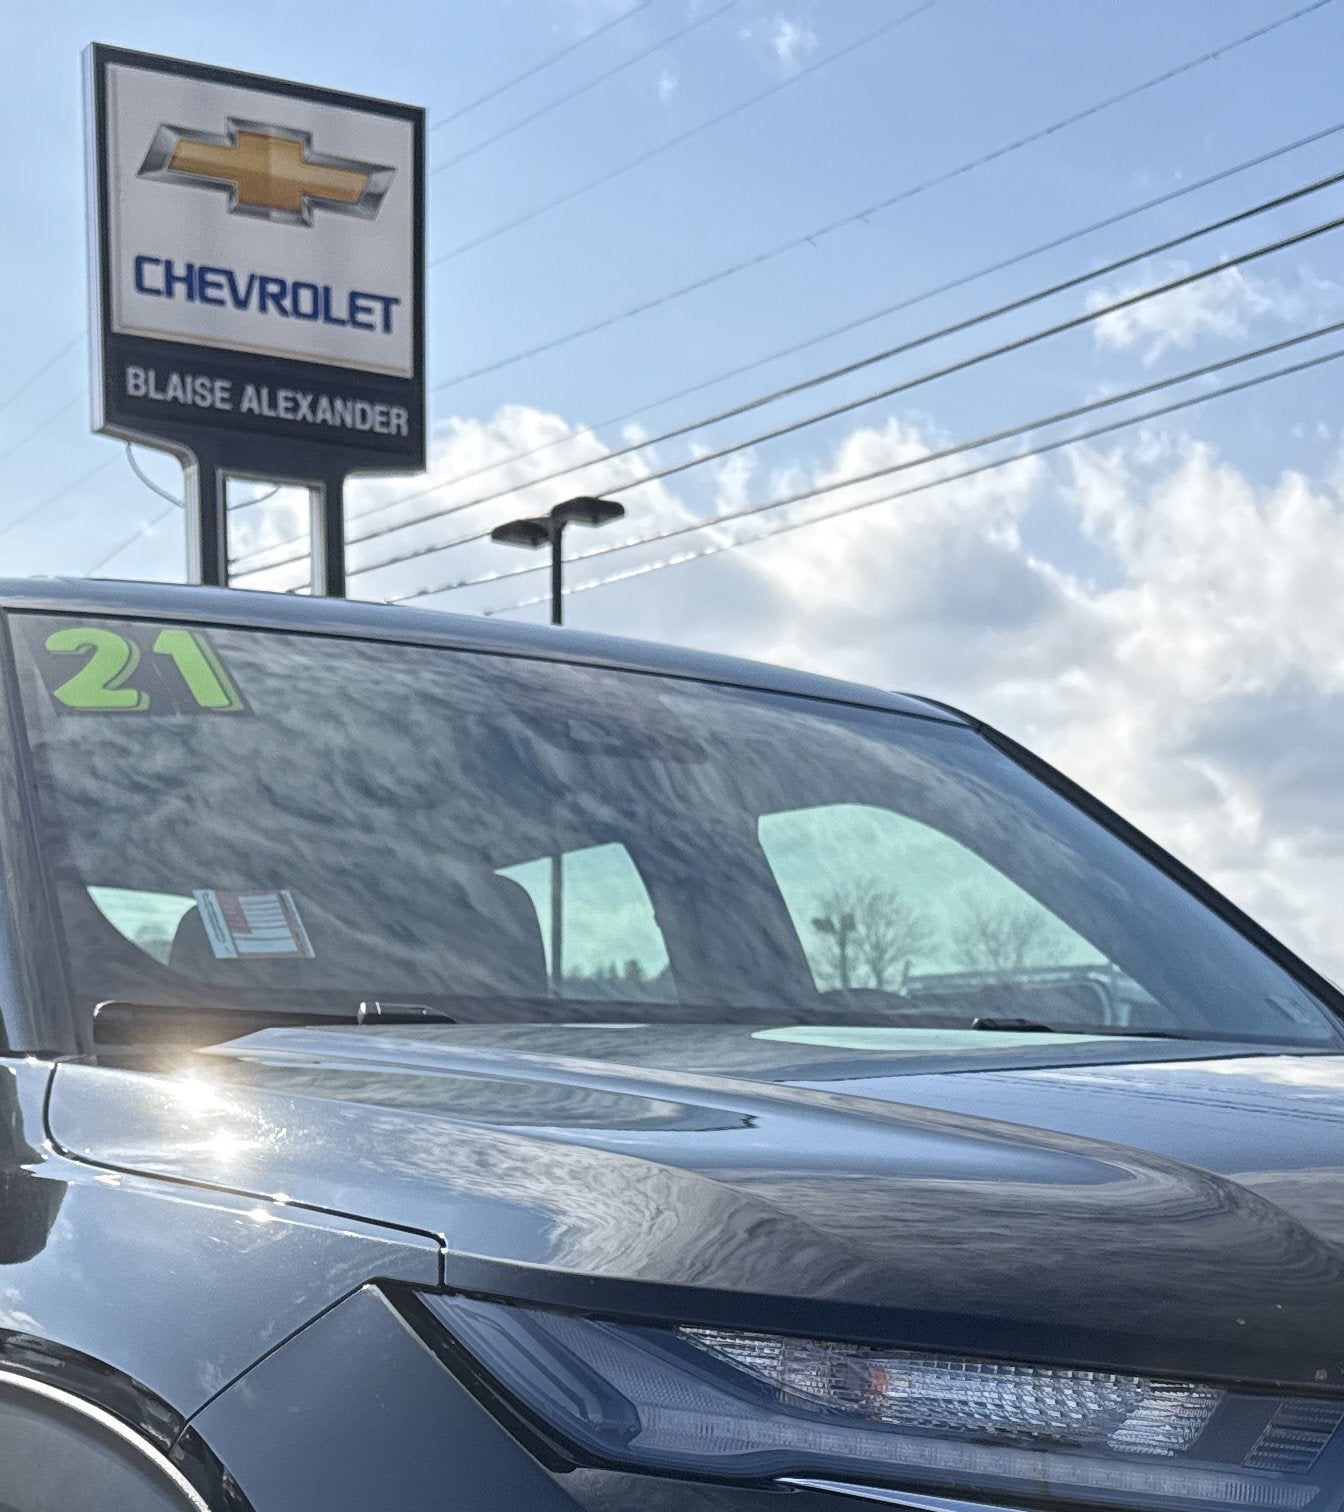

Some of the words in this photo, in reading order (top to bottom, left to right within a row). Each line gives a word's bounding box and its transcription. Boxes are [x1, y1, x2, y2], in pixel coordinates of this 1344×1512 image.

[134, 254, 401, 335] CHEVROLET
[124, 365, 233, 412] BLAISE
[239, 385, 409, 438] ALEXANDER
[45, 627, 246, 712] 21
